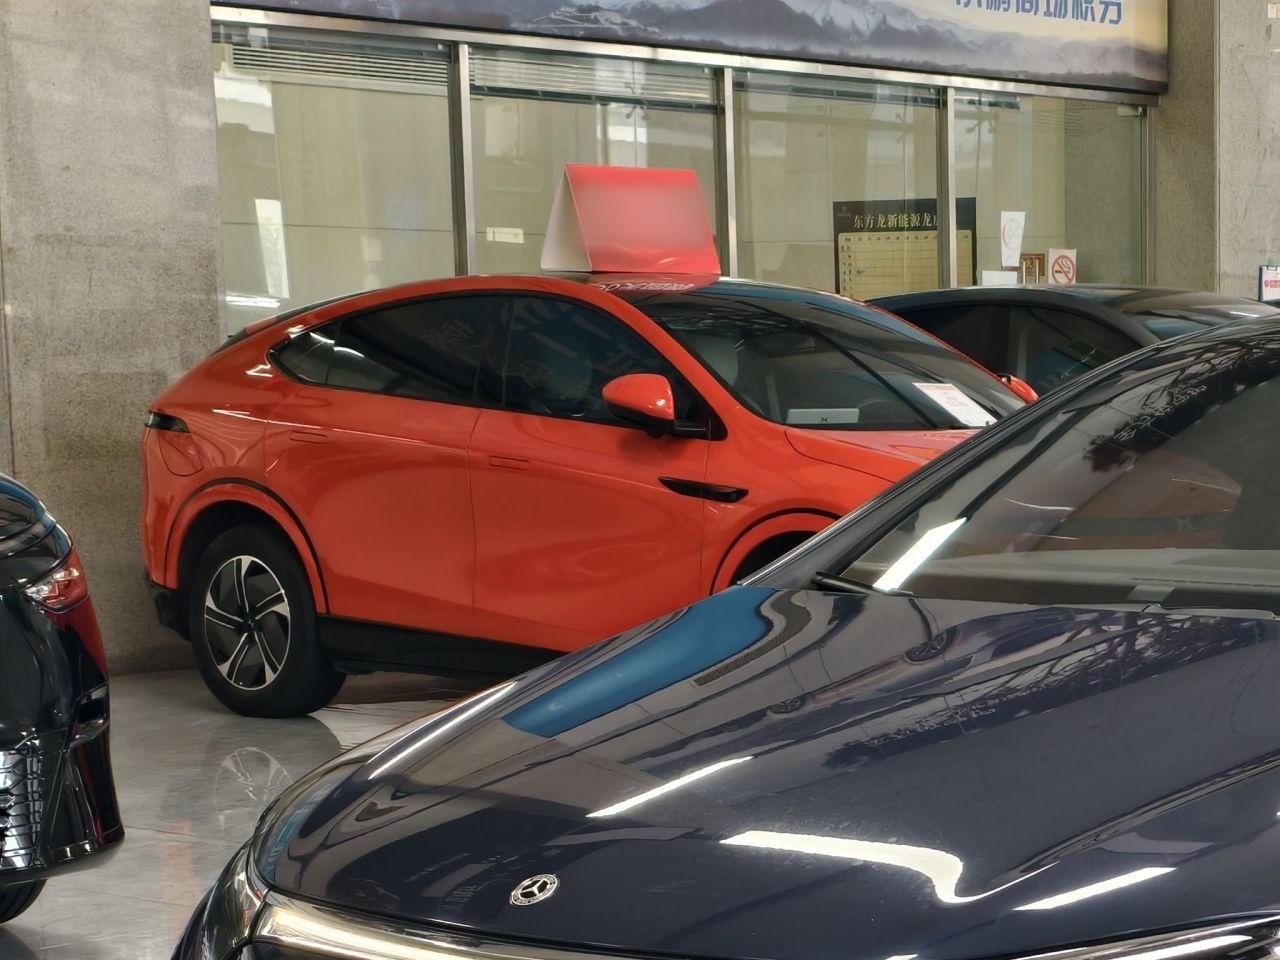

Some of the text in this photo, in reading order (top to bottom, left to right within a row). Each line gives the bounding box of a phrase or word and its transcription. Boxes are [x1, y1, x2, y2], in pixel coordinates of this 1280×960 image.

[854, 212, 937, 229] 东方龙新能源龙
